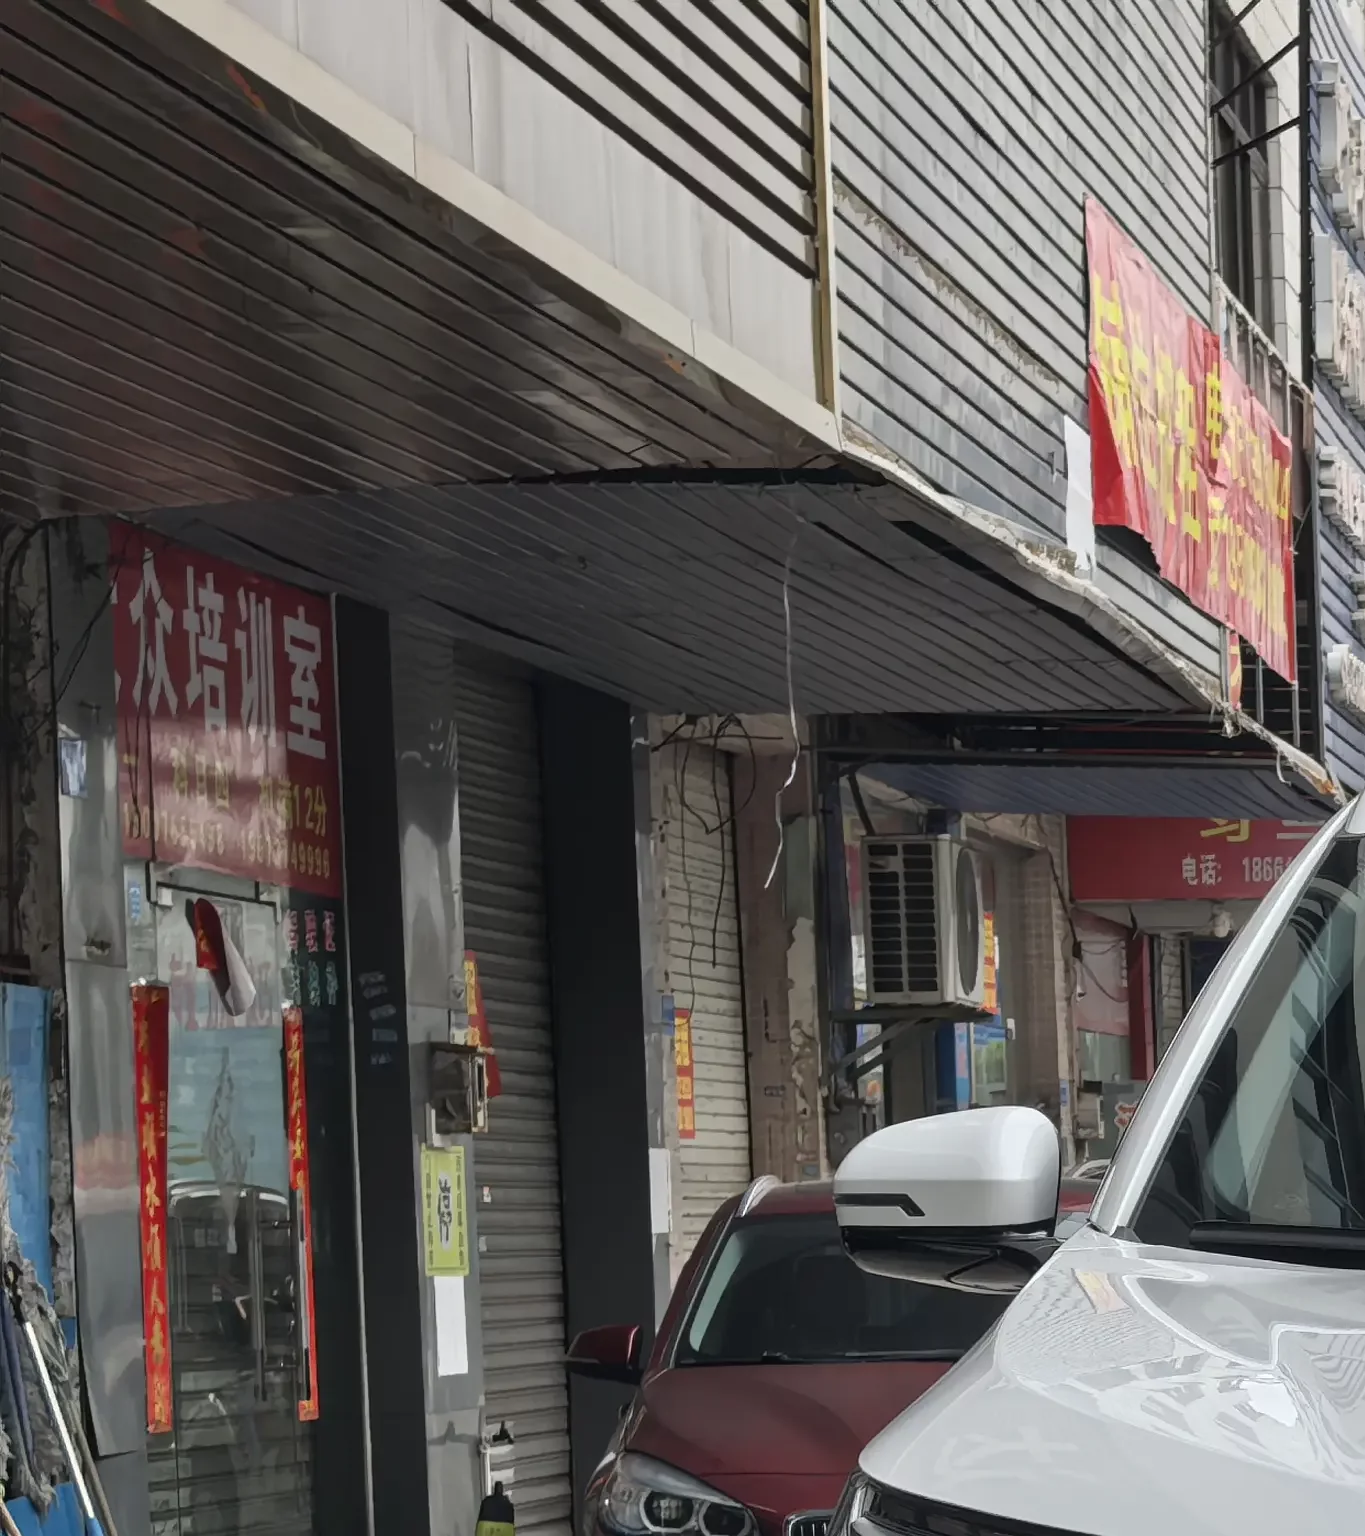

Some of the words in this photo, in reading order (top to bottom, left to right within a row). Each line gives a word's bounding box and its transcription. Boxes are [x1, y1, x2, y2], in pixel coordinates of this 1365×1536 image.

[111, 547, 326, 760] 众培训室
[1242, 856, 1291, 883] 1866
